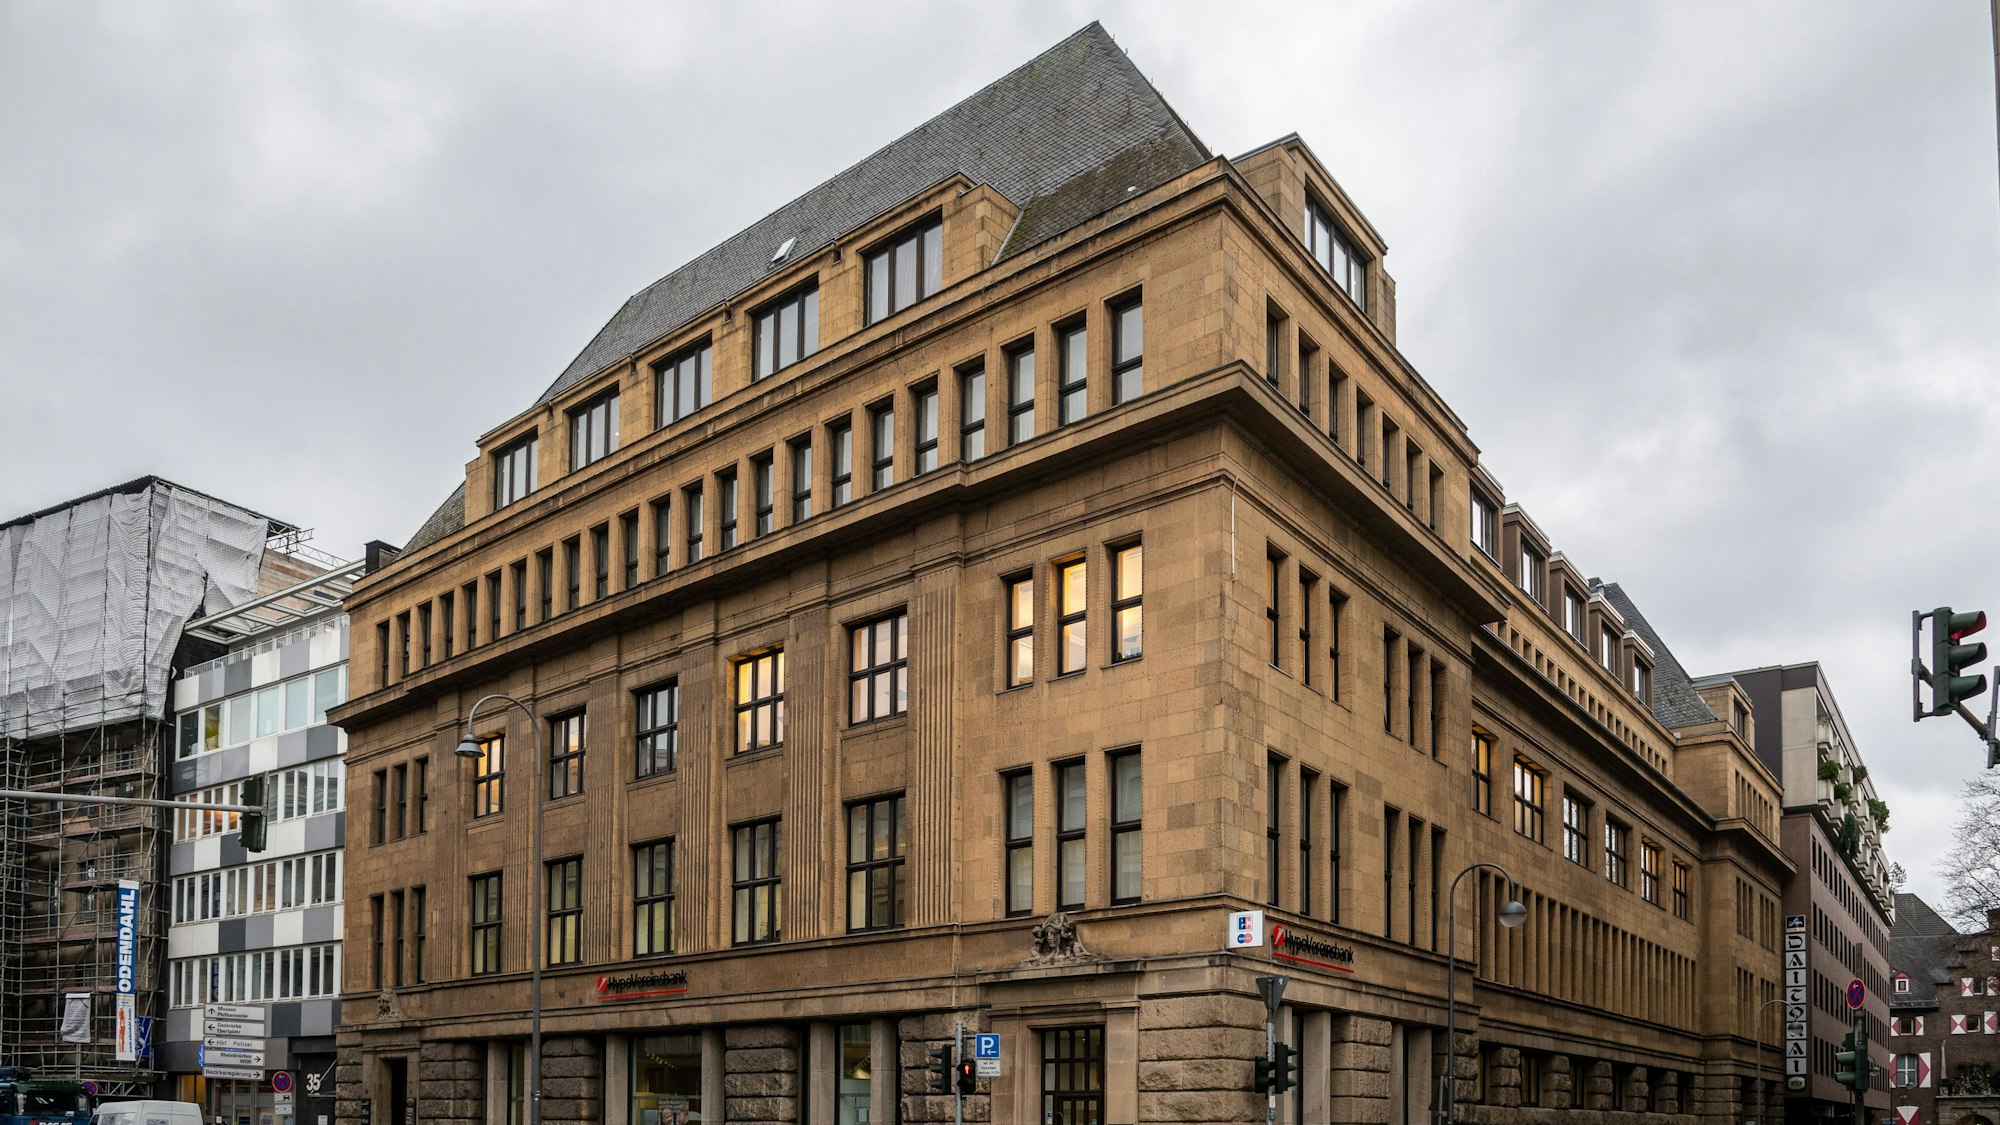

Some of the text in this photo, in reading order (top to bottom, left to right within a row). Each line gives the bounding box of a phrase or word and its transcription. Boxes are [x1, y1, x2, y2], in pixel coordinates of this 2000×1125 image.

[118, 890, 136, 993] ODENDAHL
[1285, 929, 1353, 963] HypoVereinsbank
[608, 969, 687, 993] HypoVereinsbank
[1788, 935, 1804, 1073] DAITOAI
[982, 1037, 994, 1055] P
[206, 1069, 252, 1077] Bezirksregierung
[306, 1073, 321, 1092] 35
